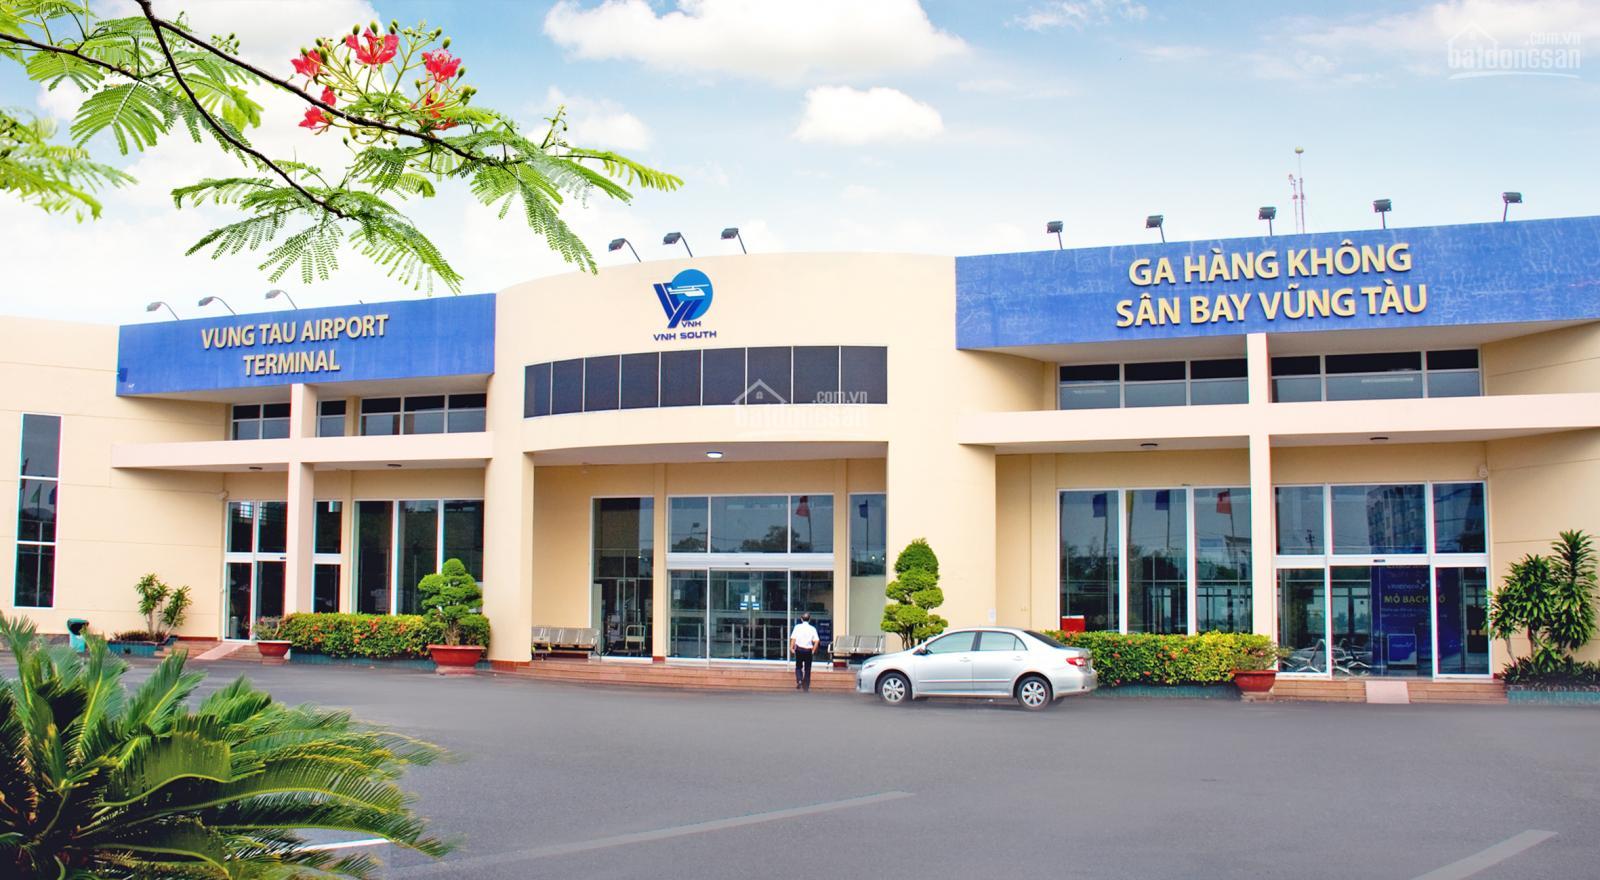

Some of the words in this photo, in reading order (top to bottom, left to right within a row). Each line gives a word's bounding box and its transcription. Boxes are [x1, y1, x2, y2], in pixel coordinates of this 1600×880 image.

[1128, 256, 1176, 287] GA
[1184, 247, 1280, 283] HÀNG
[1287, 239, 1412, 277] KHÔNG
[1116, 292, 1181, 328] SÂN
[1190, 292, 1251, 325] BAY
[1258, 282, 1356, 320] VŨNG
[1361, 278, 1428, 315] TÀU
[201, 325, 255, 350] VUNG
[259, 321, 297, 345] TAU
[301, 314, 389, 343] AIRPORT
[653, 333, 676, 341] VNH
[680, 330, 717, 339] SOUTH
[681, 320, 702, 328] VNH
[243, 350, 342, 376] TERMINAL
